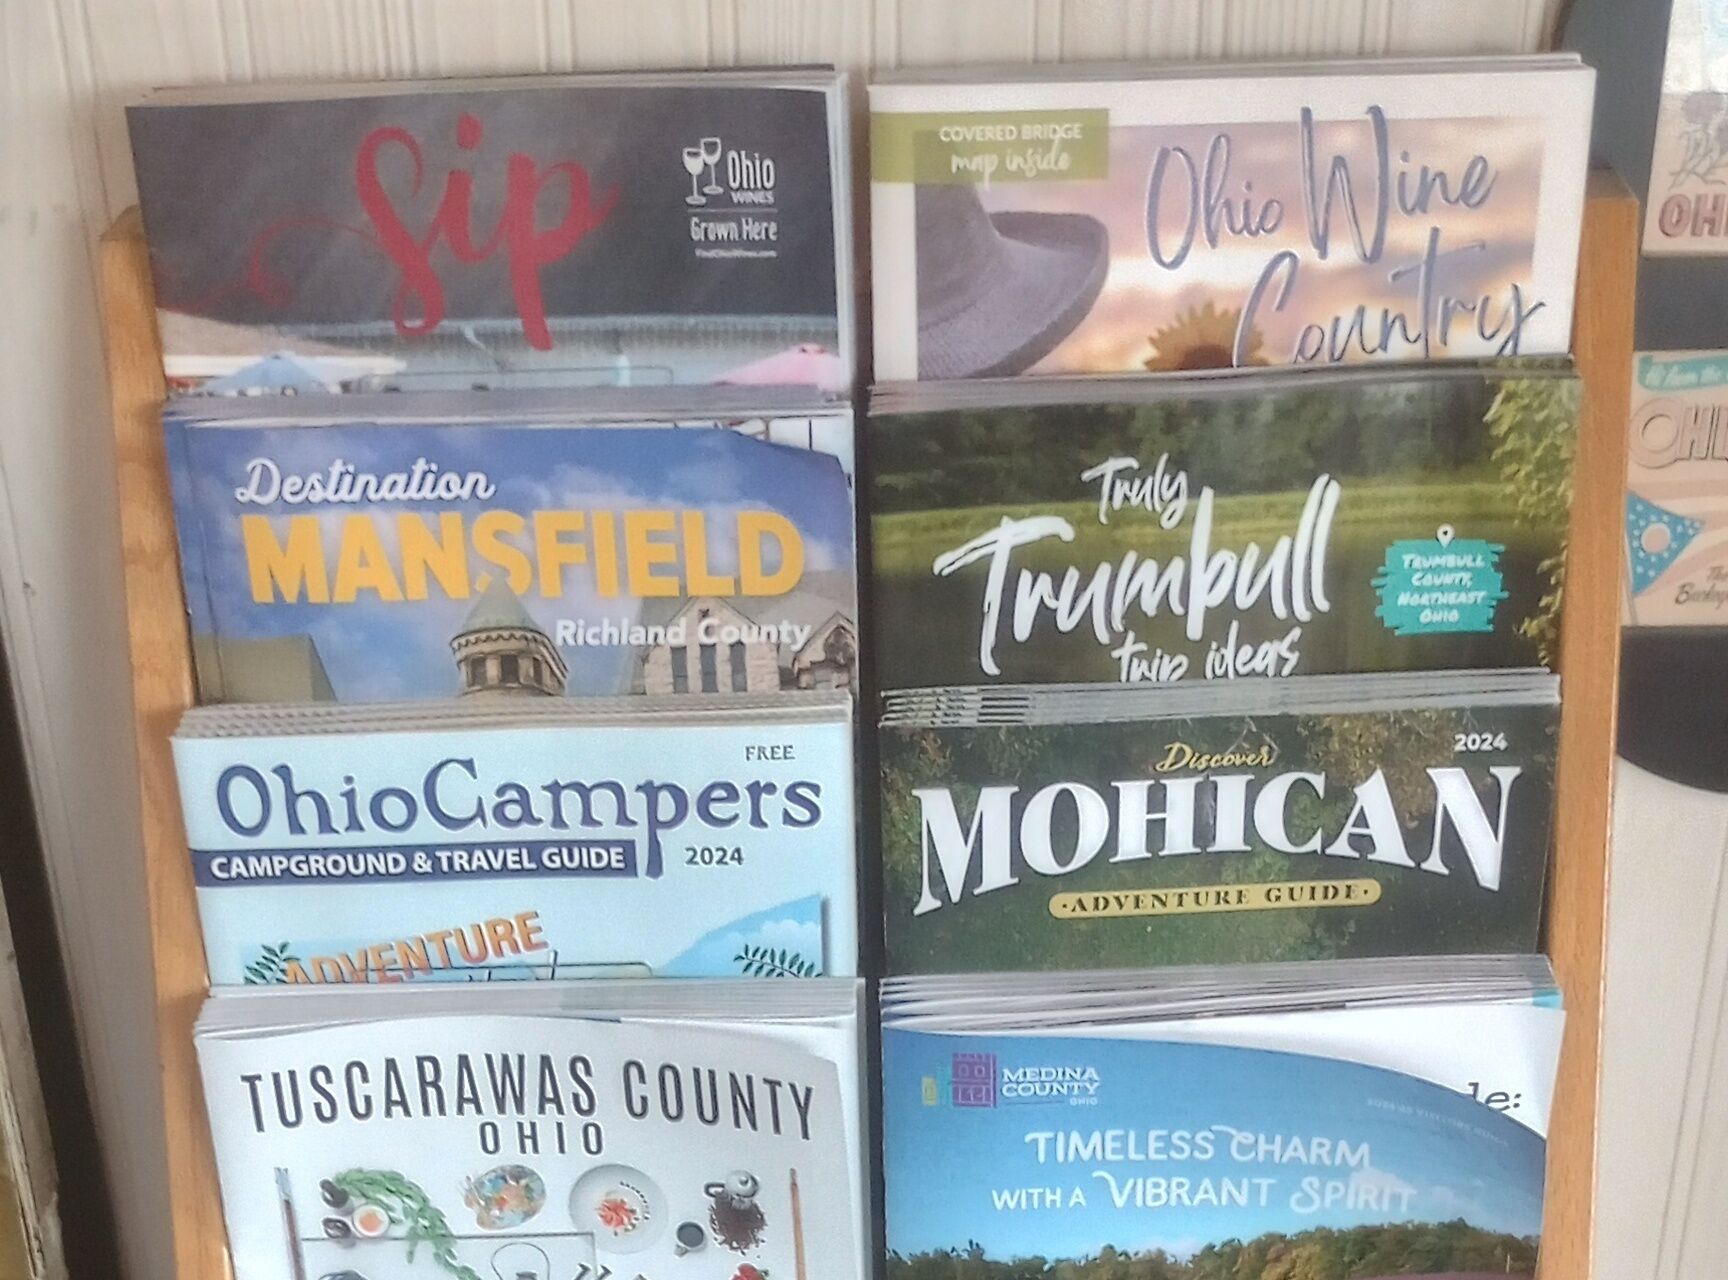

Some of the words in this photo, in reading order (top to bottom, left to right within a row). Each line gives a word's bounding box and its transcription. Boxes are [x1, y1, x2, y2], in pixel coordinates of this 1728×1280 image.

[939, 125, 1018, 142] COVERED
[1021, 123, 1083, 141] BRIDGE
[727, 149, 775, 190] Ohio
[951, 153, 1000, 188] map
[1003, 140, 1071, 174] inside
[1144, 132, 1284, 271] Ohio
[1300, 104, 1500, 264] Wine
[350, 111, 621, 351] Sip
[690, 216, 739, 241] Grown
[741, 216, 778, 241] Here
[1234, 226, 1547, 368] Country
[234, 457, 496, 506] Destination
[1081, 453, 1188, 530] Truly
[241, 509, 806, 605] MANSFIELD
[933, 474, 1341, 677] Trumbull
[1402, 553, 1486, 570] TRUMBULL
[1397, 590, 1488, 607] NORTHEAST
[1419, 608, 1460, 625] OHIO
[556, 618, 685, 648] Richland
[698, 618, 812, 651] County
[1205, 620, 1302, 678] ideas
[745, 745, 796, 762] FREE
[1155, 742, 1277, 773] Discover
[1454, 732, 1508, 753] 2024
[215, 758, 823, 881] OhioCampers
[912, 765, 1522, 917] MOHICAN
[210, 852, 407, 880] CAMPGROUND
[412, 849, 434, 875] &
[435, 848, 537, 874] TRAVEL
[542, 846, 627, 871] GUIDE
[684, 846, 745, 867] 2024
[1069, 888, 1252, 914] ADVENTURE
[1265, 884, 1359, 904] GUIDE
[284, 910, 550, 983] ADVENTURE
[1001, 1067, 1099, 1083] MEDINA
[1001, 1081, 1100, 1098] COUNTY
[240, 1052, 598, 1134] TUSCARAWAS
[622, 1059, 814, 1141] COUNTY
[479, 1120, 605, 1156] OHIO
[1025, 1128, 1216, 1166] TIMELESS
[1208, 1125, 1372, 1169] CHARM
[991, 1187, 1061, 1211] WITH
[1067, 1187, 1086, 1209] A
[1093, 1171, 1274, 1210] VIBRANT
[1289, 1175, 1418, 1215] SPIRIT
